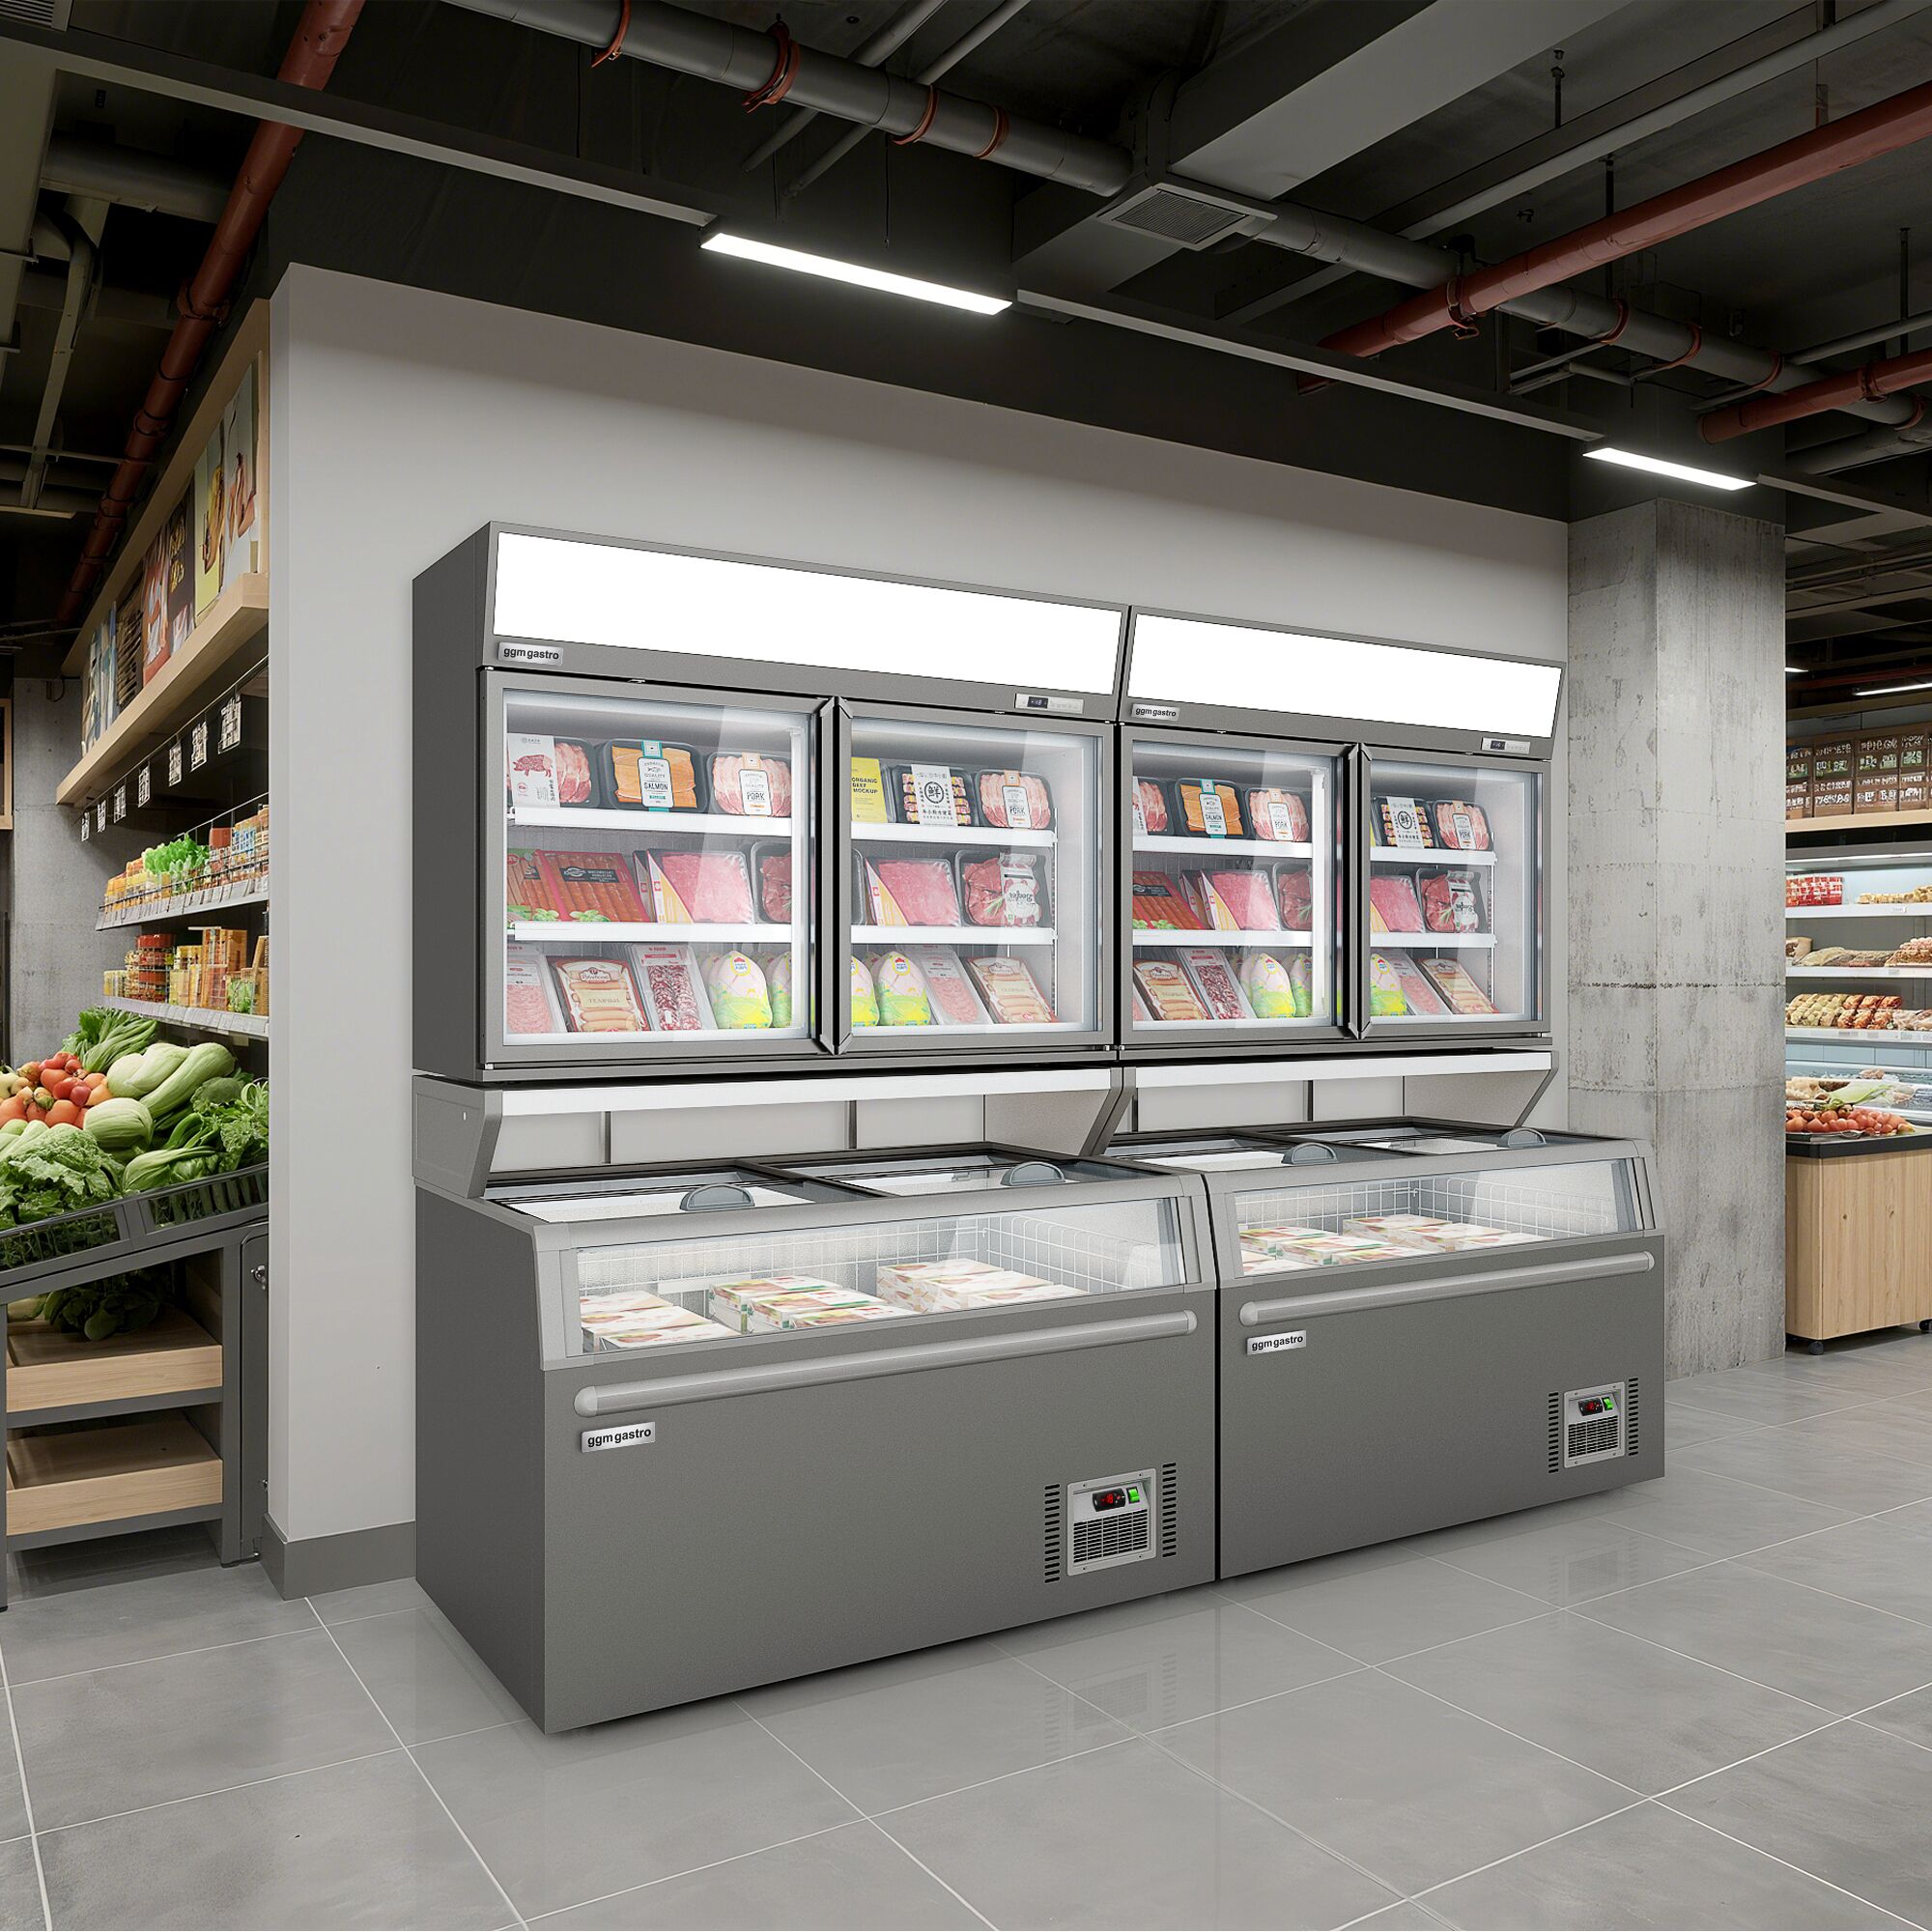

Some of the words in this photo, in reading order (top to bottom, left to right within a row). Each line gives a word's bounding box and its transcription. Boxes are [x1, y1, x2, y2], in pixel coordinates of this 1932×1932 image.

[503, 648, 526, 658] ggm
[526, 650, 559, 660] gastro
[643, 781, 668, 790] SALMON
[747, 791, 765, 801] PORK
[1251, 1340, 1272, 1351] ggm
[1273, 1336, 1303, 1349] gastro
[587, 1434, 612, 1447] ggm
[614, 1429, 651, 1443] gastro
